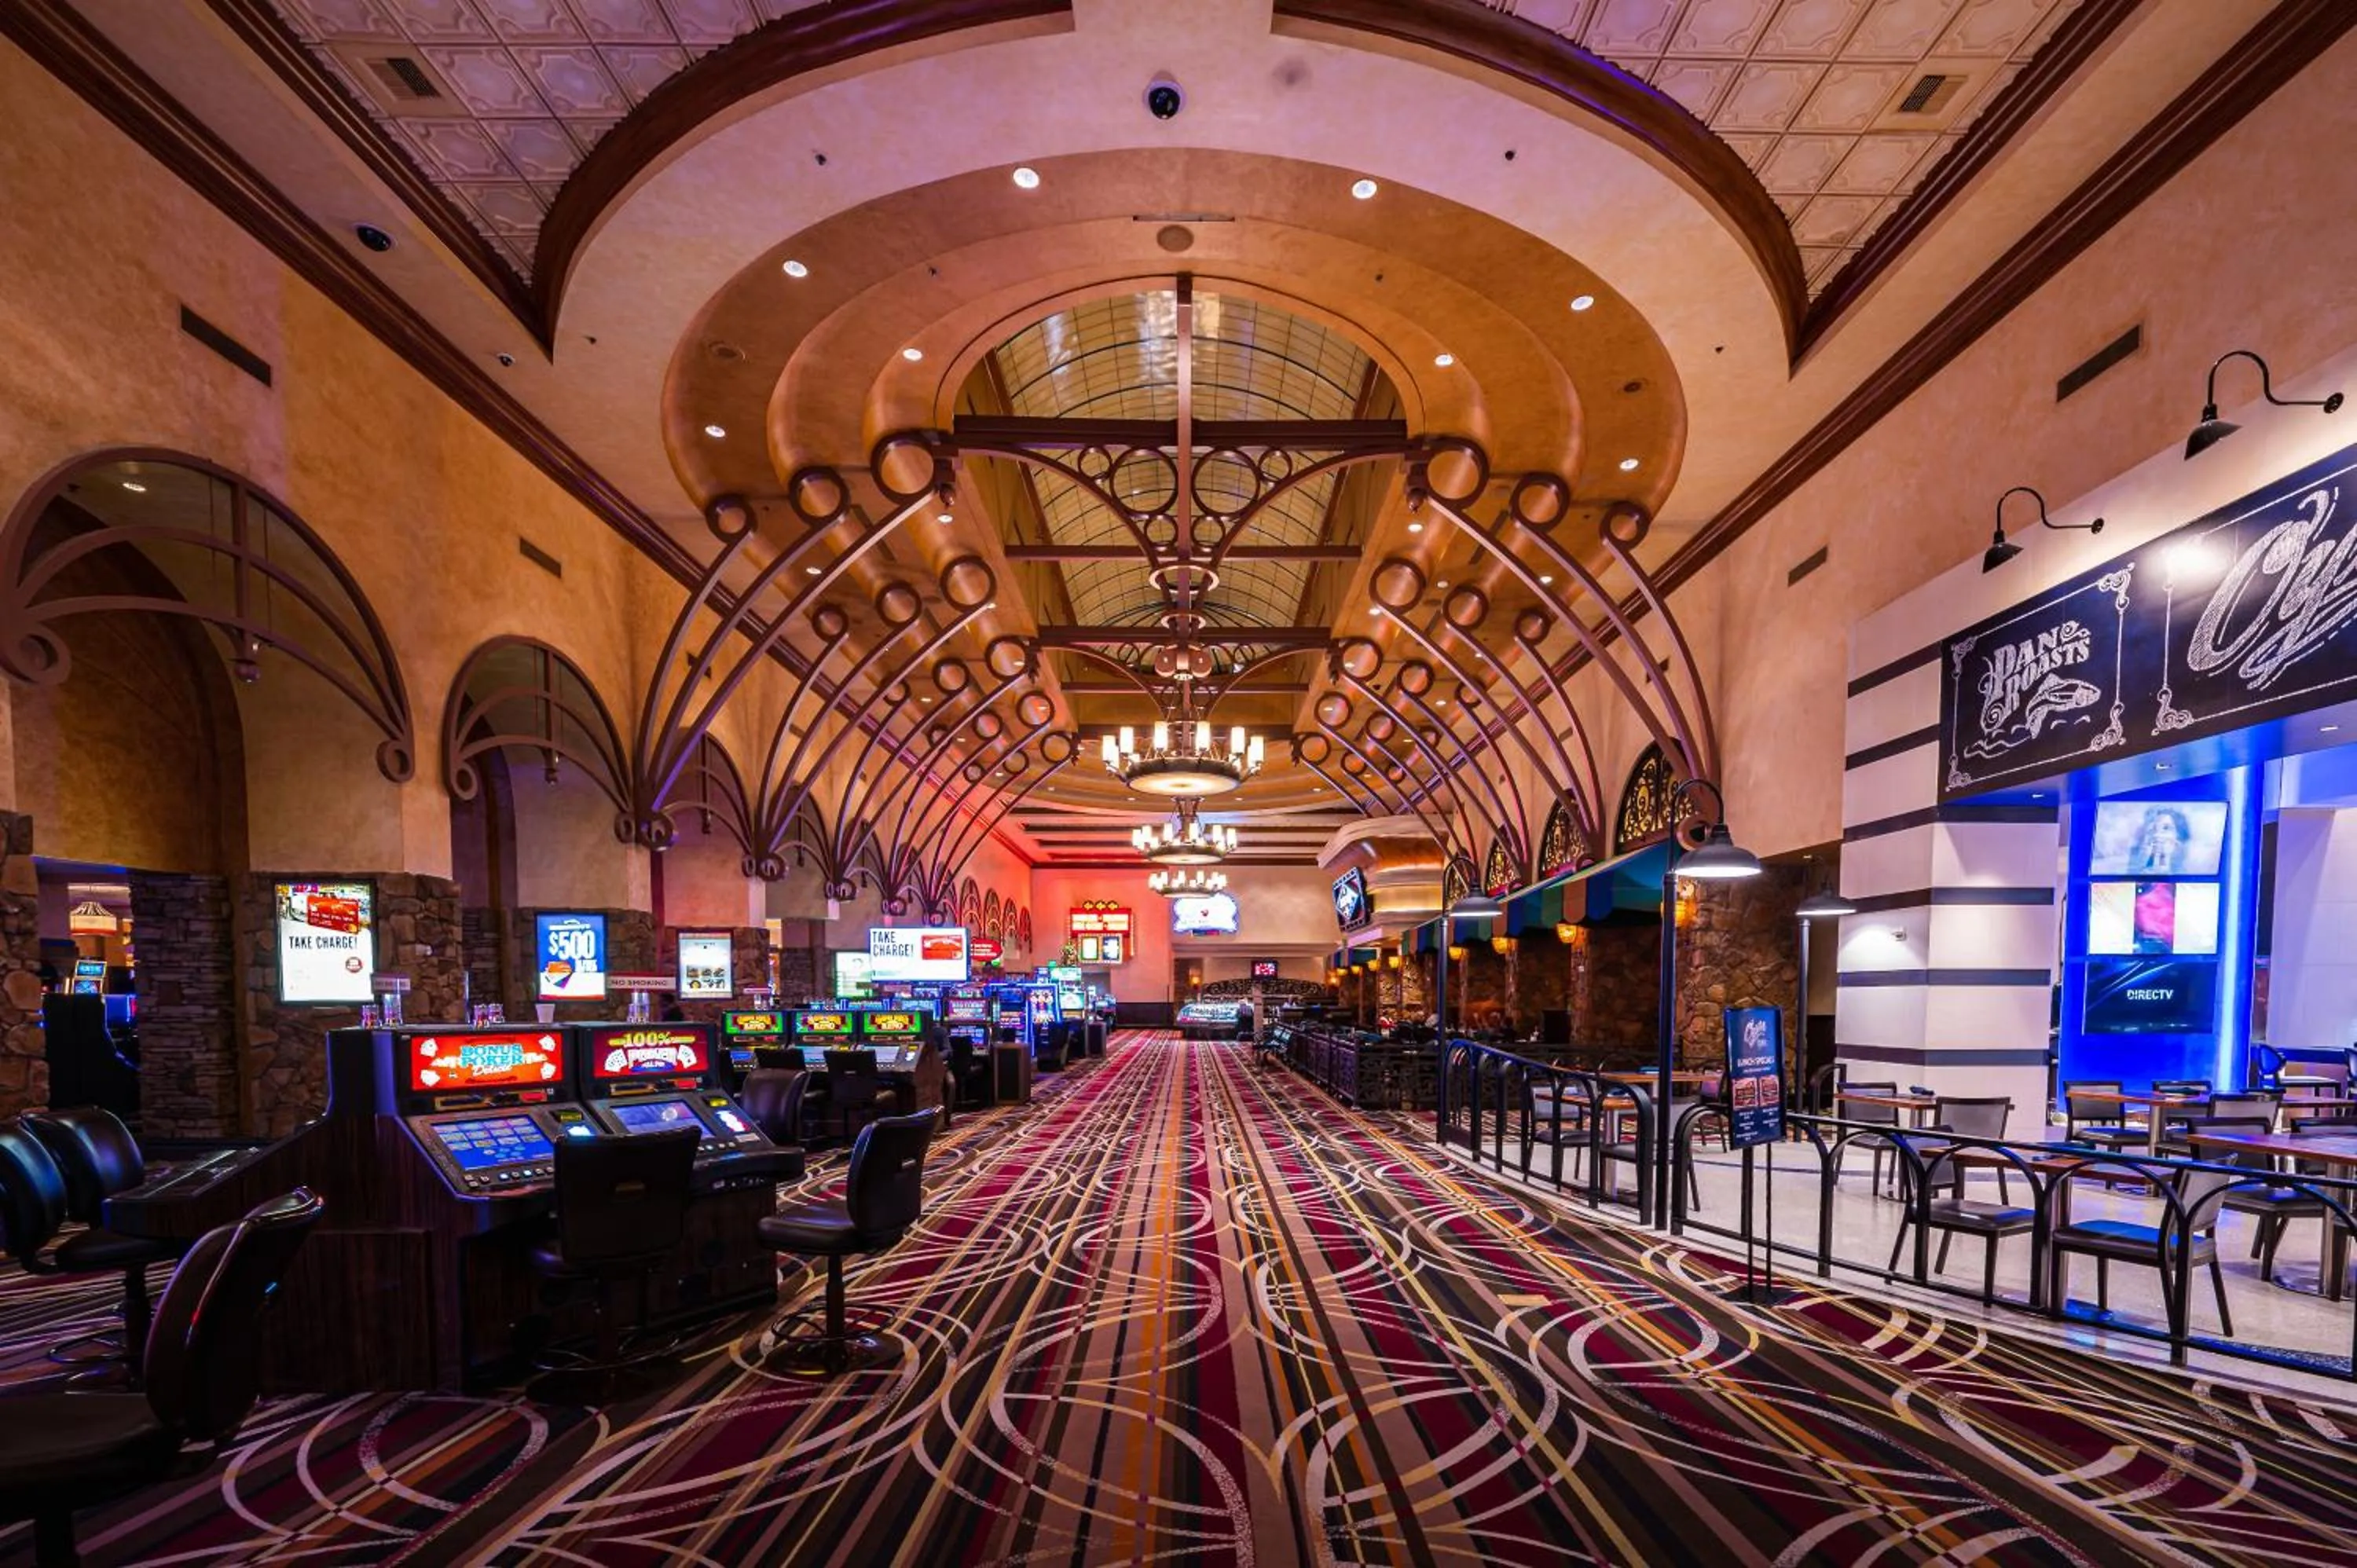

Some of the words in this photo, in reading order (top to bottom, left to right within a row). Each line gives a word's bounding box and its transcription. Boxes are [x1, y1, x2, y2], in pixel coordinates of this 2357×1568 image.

[1980, 622, 2080, 705] PAN
[2001, 637, 2091, 720] ROASTS
[288, 936, 313, 950] TAKE
[315, 936, 358, 950] CHARGE!
[872, 931, 896, 943] TAKE
[548, 929, 596, 960] $500
[872, 943, 915, 957] CHARGE!
[2126, 989, 2174, 1000] DIRECTV
[623, 1031, 673, 1048] 100%
[460, 1044, 523, 1057] BONUS
[460, 1055, 525, 1068] POKER
